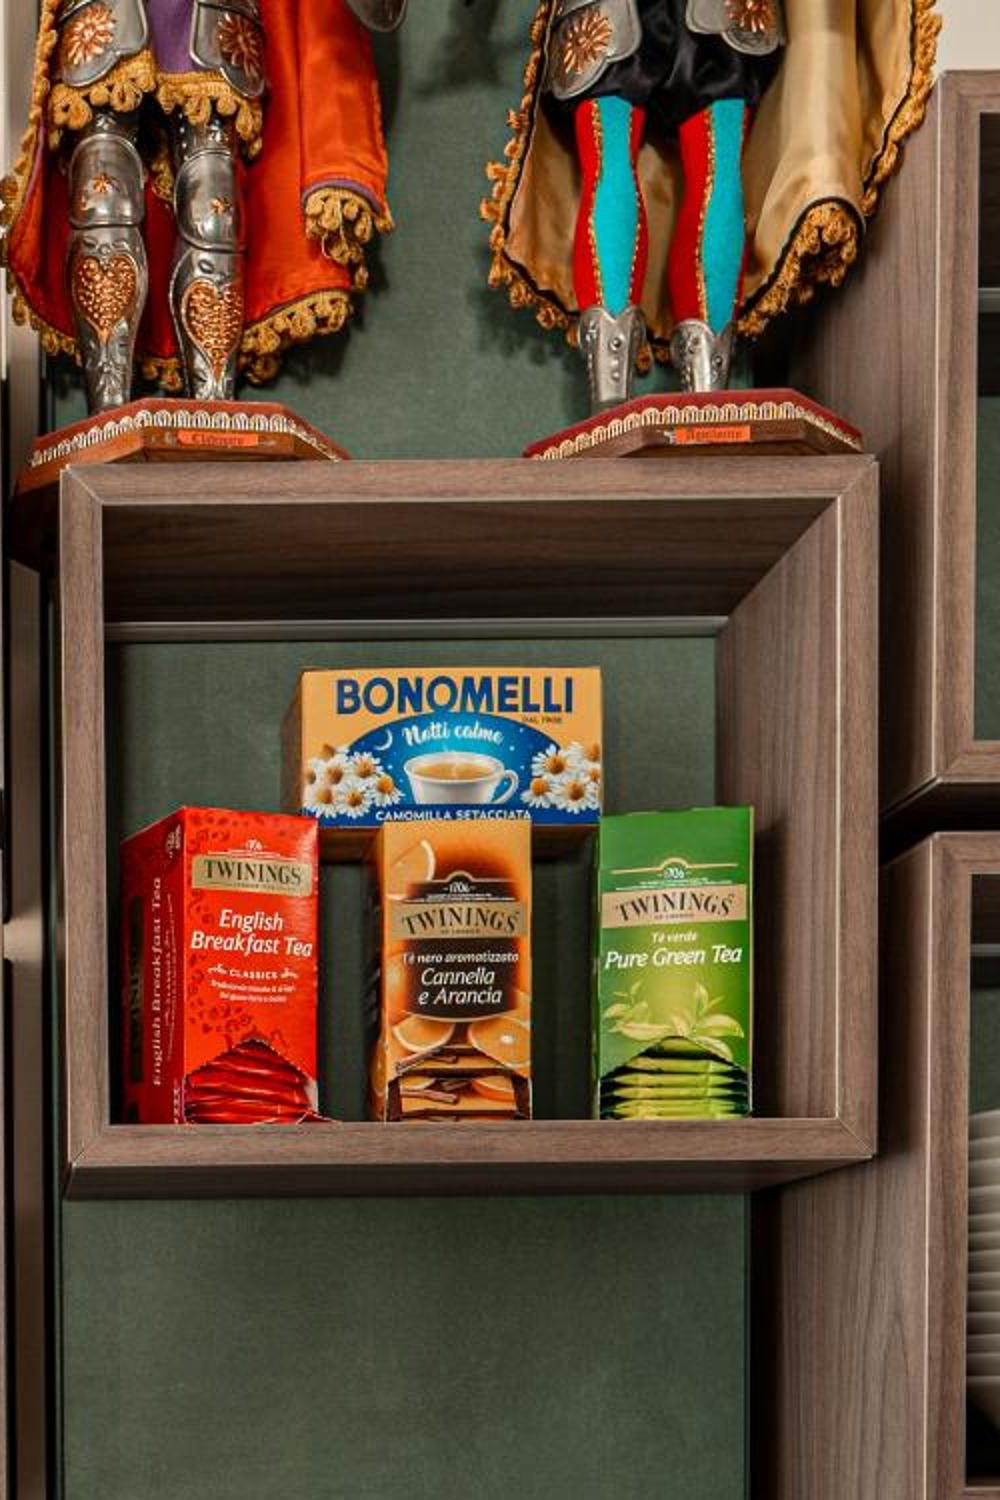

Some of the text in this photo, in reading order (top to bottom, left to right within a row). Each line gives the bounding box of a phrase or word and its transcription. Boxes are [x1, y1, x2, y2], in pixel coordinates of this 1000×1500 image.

[335, 675, 574, 715] BONOMELLI
[402, 720, 505, 747] Notti calme
[374, 808, 532, 822] CAMOMILLA SETACCIATA
[203, 858, 302, 886] TWININGS
[615, 891, 735, 921] TWININGS
[218, 908, 284, 934] English
[401, 906, 519, 935] TWININGS
[190, 930, 314, 958] Breakfast Tea
[667, 931, 698, 942] verde
[417, 953, 443, 964] nero
[444, 950, 519, 964] aromatizzato
[604, 944, 744, 970] Pure Green Tea
[151, 877, 163, 1087] English Breakfast Tea
[420, 967, 496, 986] Cannella
[418, 986, 504, 1005] e Arancia
